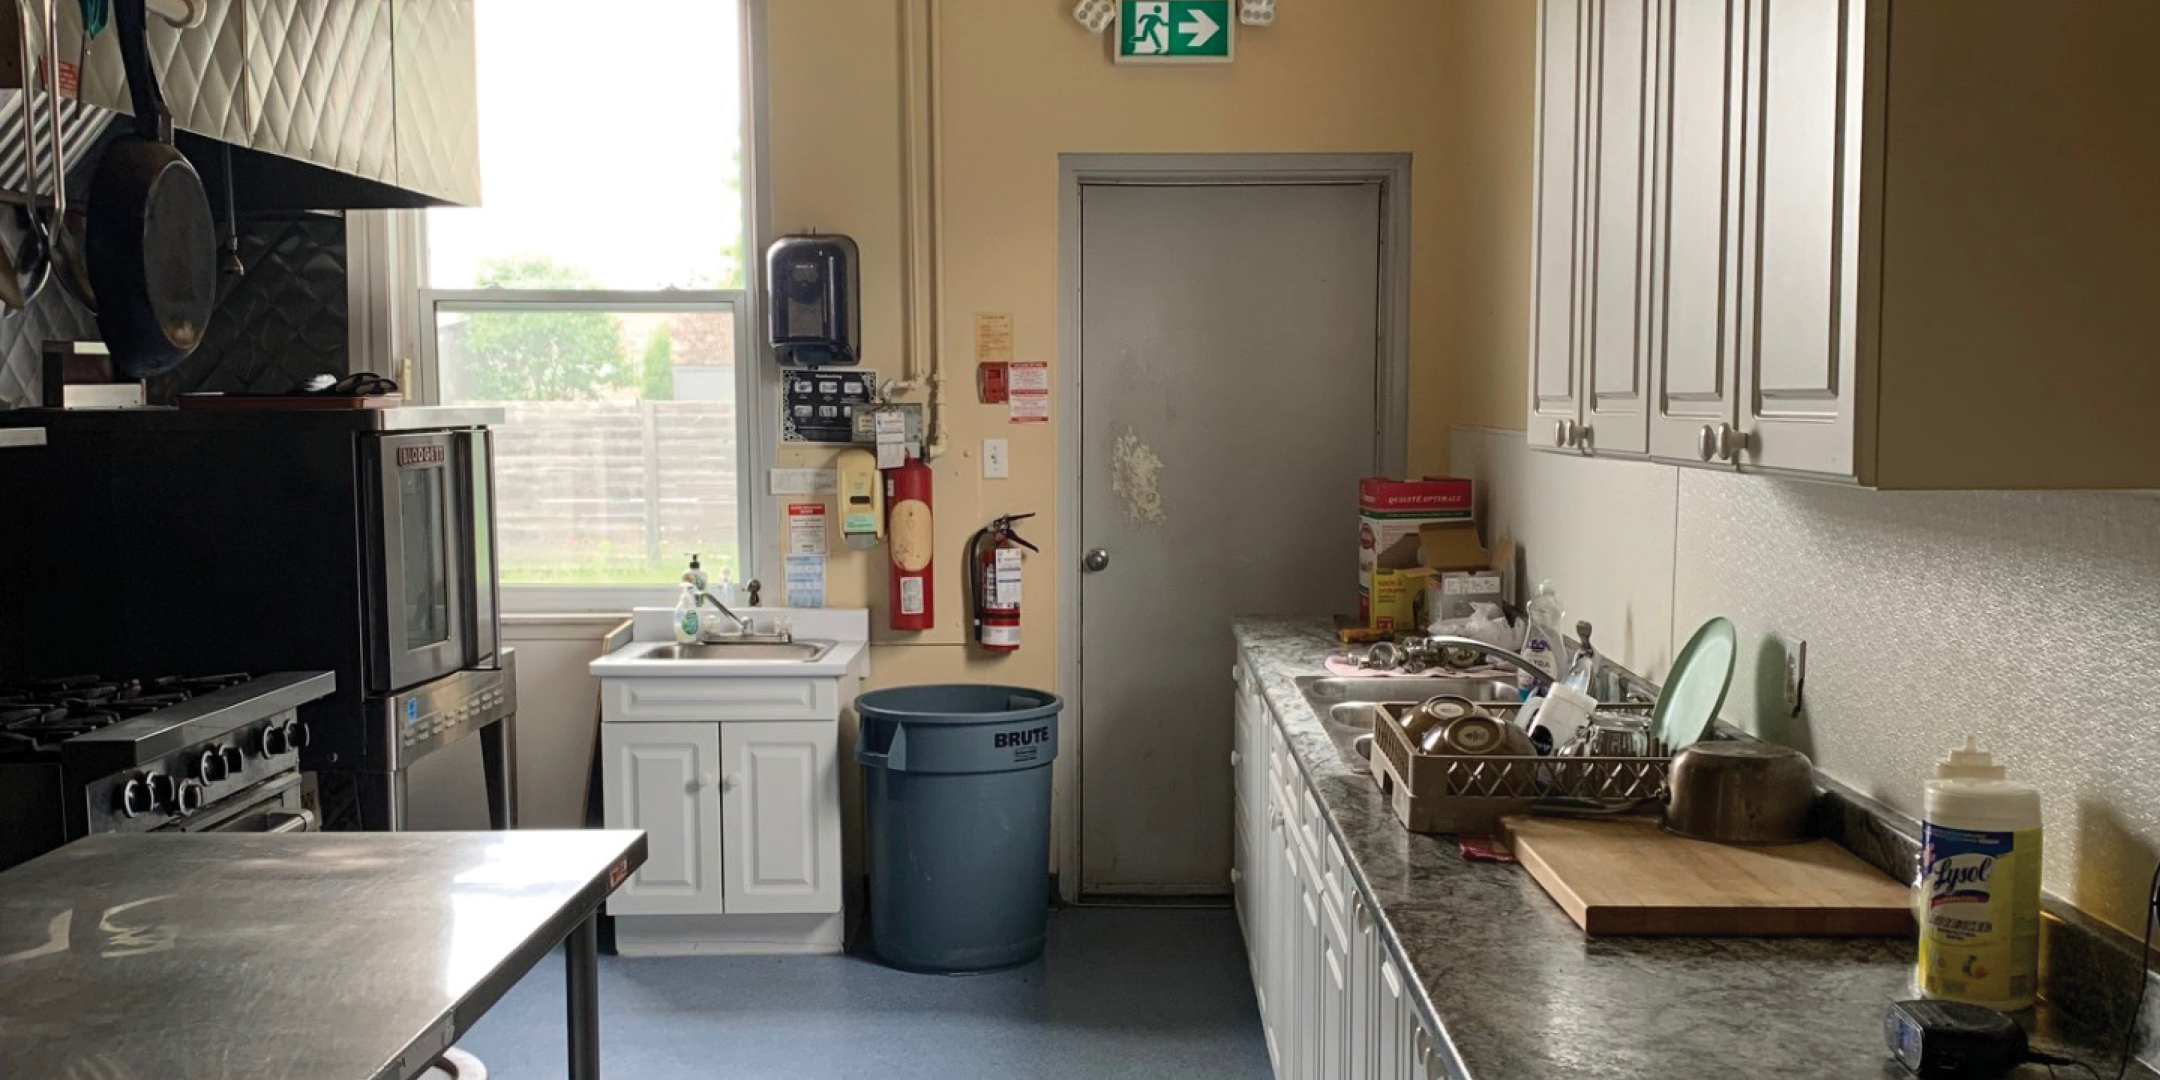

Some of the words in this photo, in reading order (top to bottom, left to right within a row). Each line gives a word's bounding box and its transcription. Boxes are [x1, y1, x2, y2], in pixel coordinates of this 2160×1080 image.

[403, 447, 444, 463] BLODGETT
[995, 726, 1050, 748] BRUTE
[1933, 857, 1992, 891] Lysol
